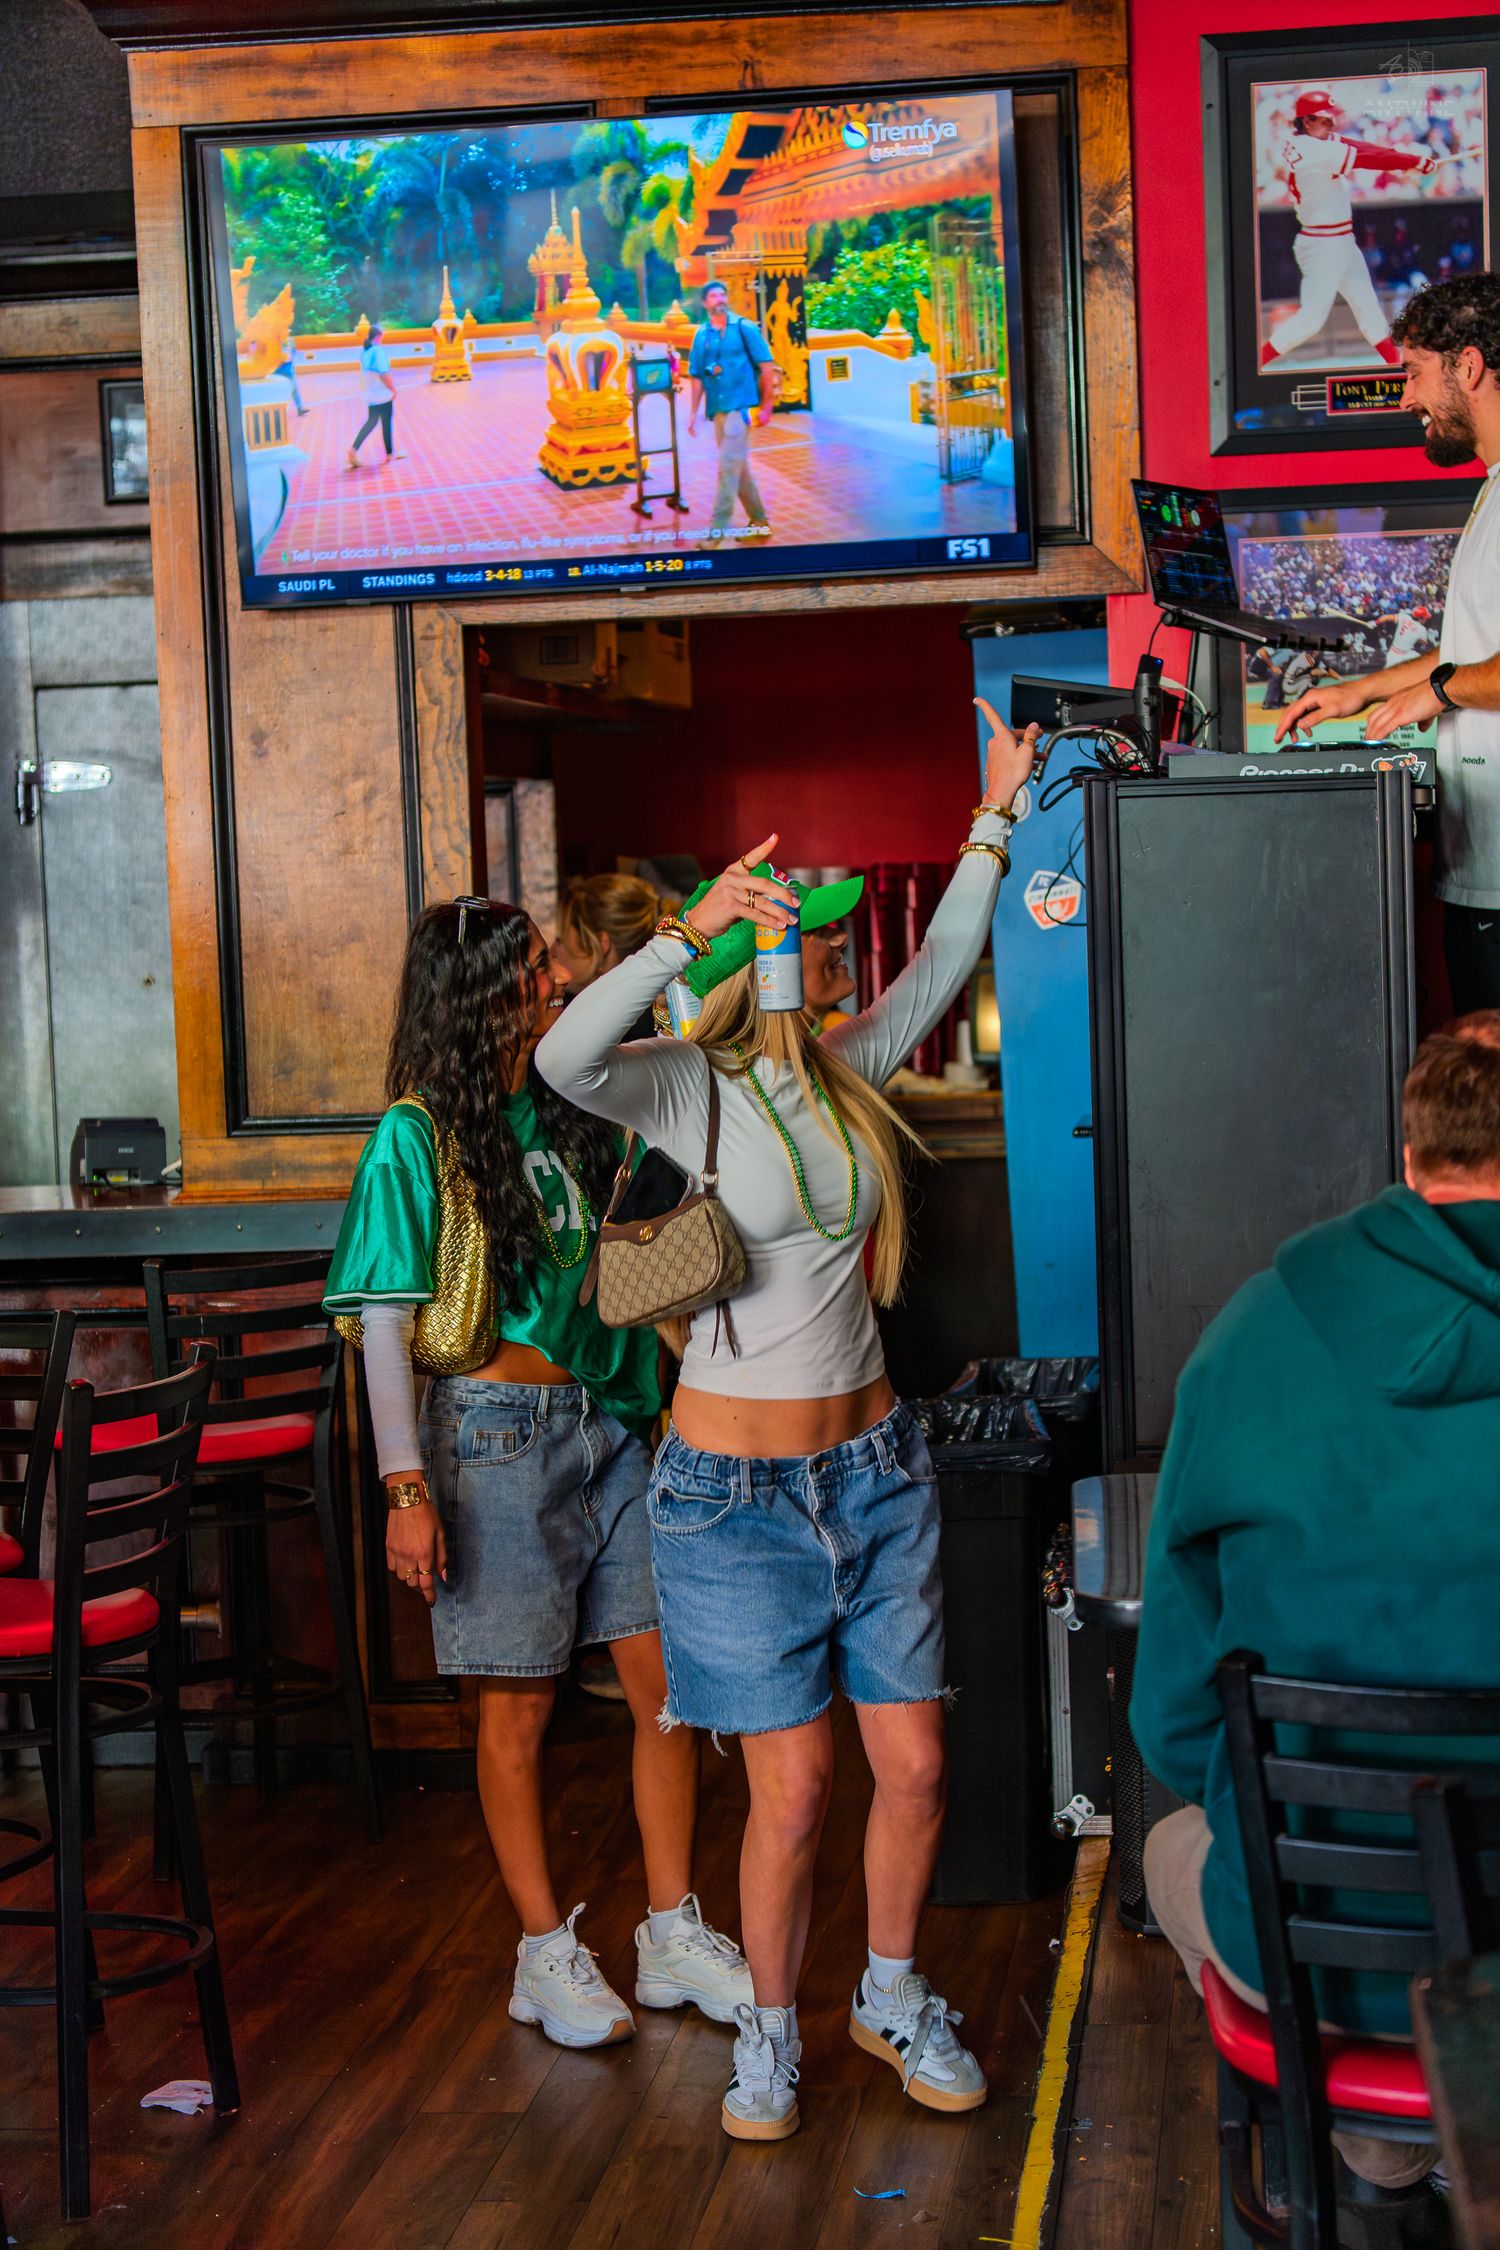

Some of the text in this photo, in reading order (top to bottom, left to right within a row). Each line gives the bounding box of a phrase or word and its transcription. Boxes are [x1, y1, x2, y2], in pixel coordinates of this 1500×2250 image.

[867, 119, 958, 144] Tremfya
[291, 550, 311, 562] Tell
[340, 548, 379, 559] doctor
[947, 538, 991, 560] FS1
[278, 580, 317, 594] SAUDI
[319, 579, 336, 591] PL
[362, 573, 436, 590] STANDINGS
[535, 568, 555, 578] PTS
